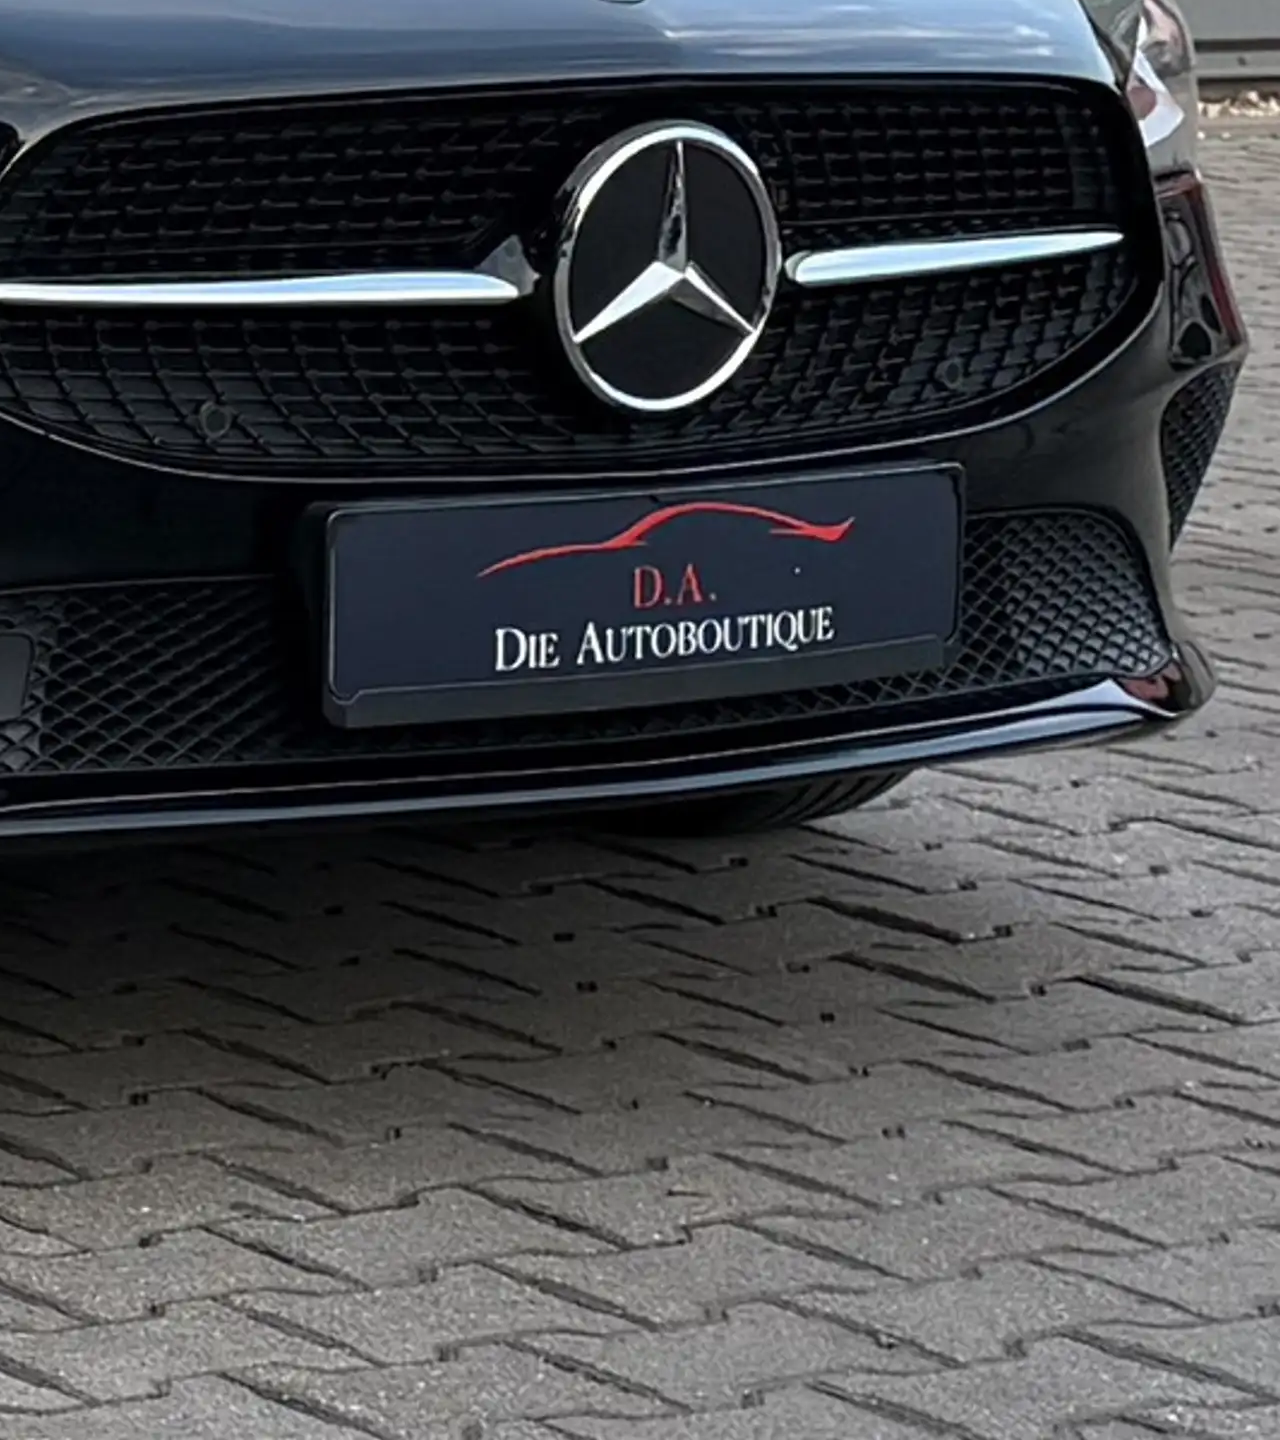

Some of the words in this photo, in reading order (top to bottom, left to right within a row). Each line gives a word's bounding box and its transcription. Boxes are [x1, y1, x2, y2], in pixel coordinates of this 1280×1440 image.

[632, 564, 717, 608] D.A.
[495, 627, 559, 671] DIE
[576, 606, 835, 665] AUTOBOUTIQUE
